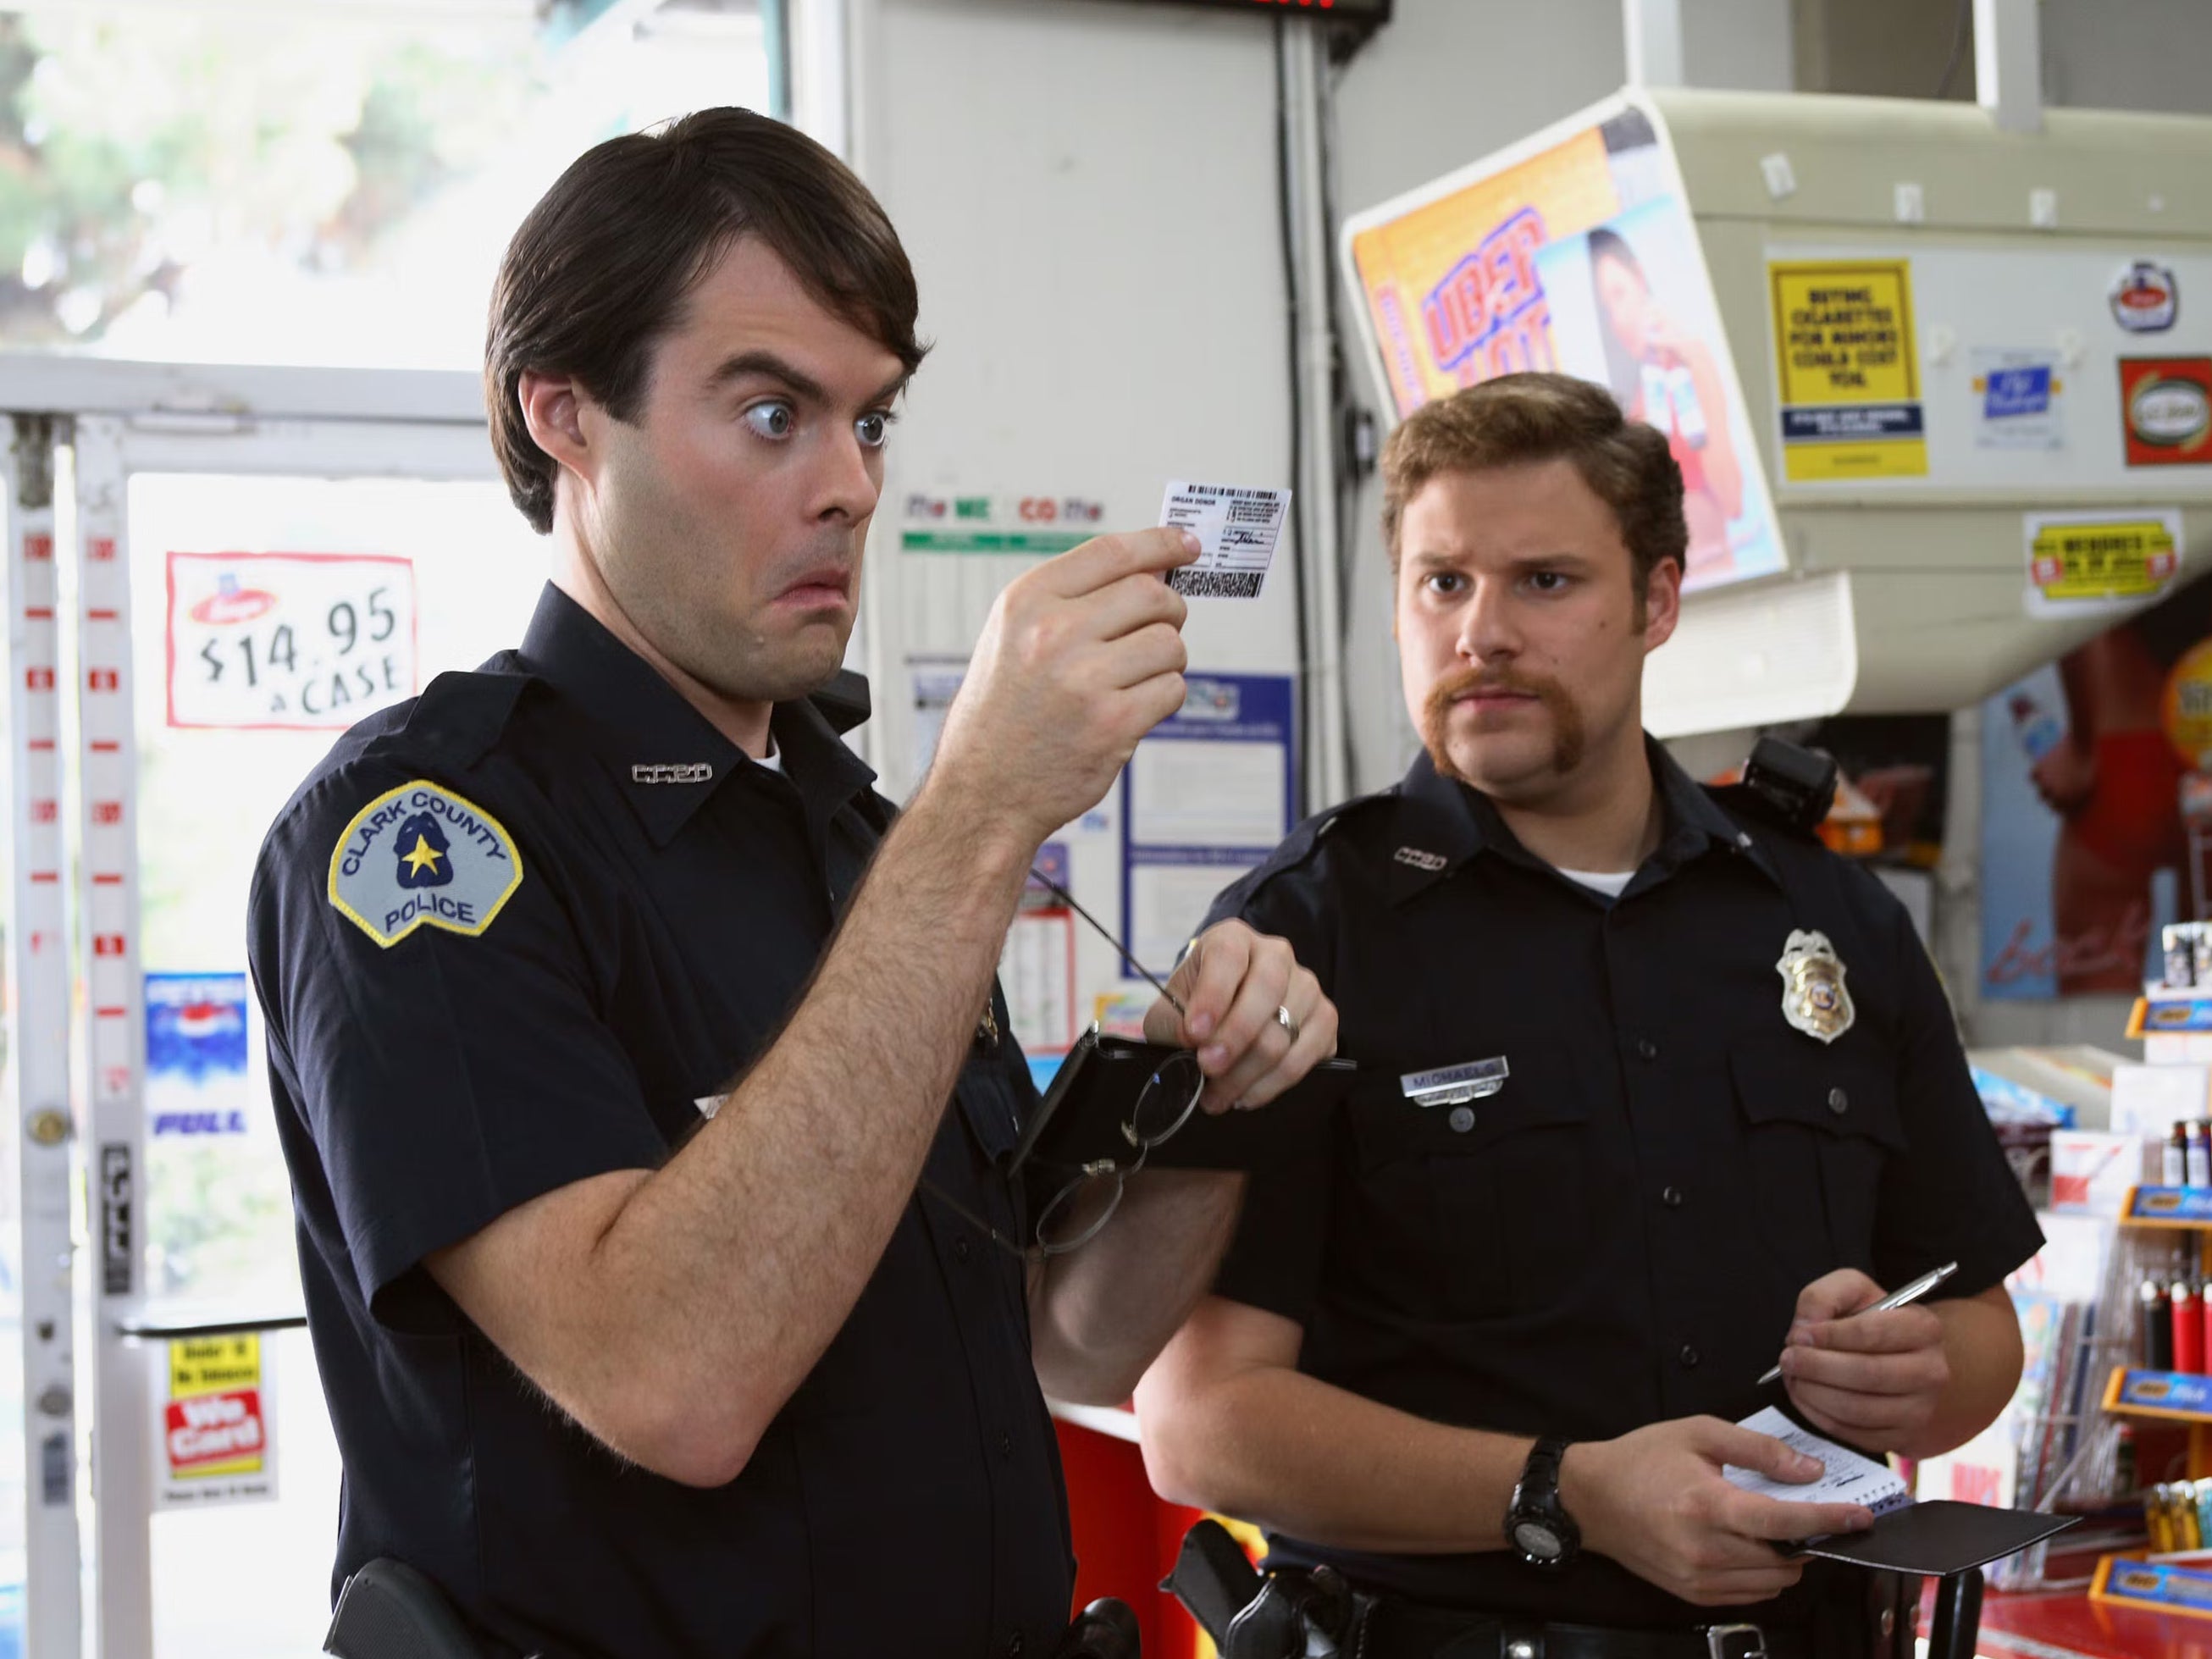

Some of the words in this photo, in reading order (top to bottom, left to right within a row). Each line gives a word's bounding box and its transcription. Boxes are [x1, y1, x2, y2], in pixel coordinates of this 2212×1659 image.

[1171, 495, 1193, 505] ORGAN
[301, 655, 396, 715] CASE
[341, 799, 407, 877] CLARK
[411, 792, 507, 860] COUNTY
[384, 893, 477, 932] POLICE
[1413, 1063, 1496, 1088] MICHAELS
[171, 1415, 261, 1459] Card
